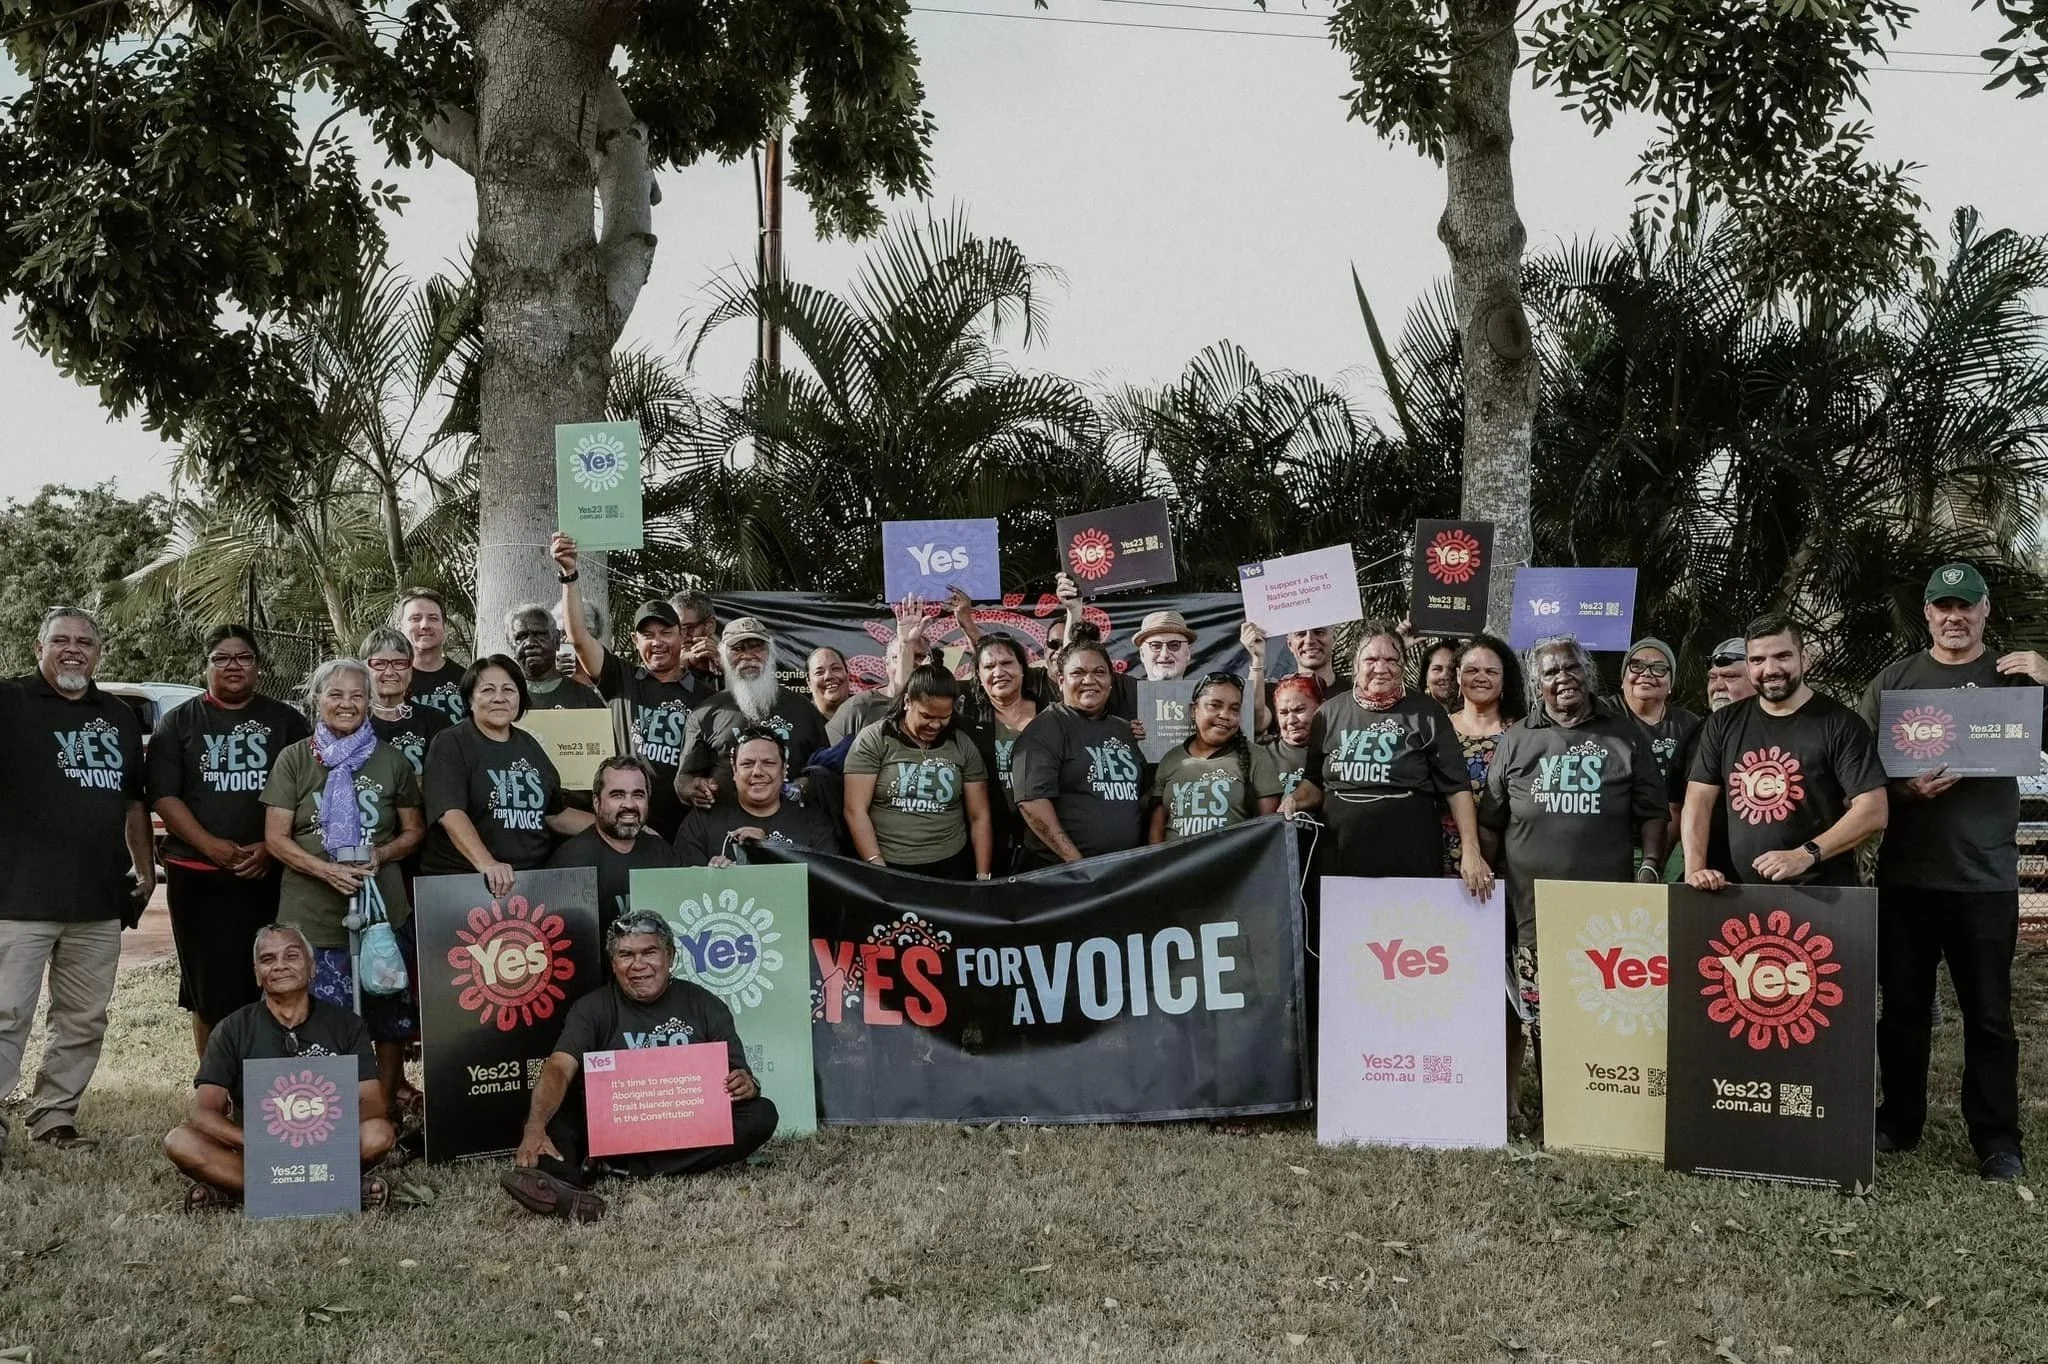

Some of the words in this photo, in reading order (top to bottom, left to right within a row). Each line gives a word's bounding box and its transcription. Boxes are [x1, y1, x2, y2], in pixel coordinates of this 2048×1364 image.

[579, 452, 616, 472] Yes
[578, 504, 602, 514] Yes23
[1121, 538, 1143, 548] Yes23
[907, 543, 969, 576] Yes
[1075, 545, 1105, 563] Yes
[1434, 547, 1469, 565] Yes
[1242, 566, 1261, 577] Yes
[1269, 579, 1301, 590] support
[1310, 573, 1328, 582] First
[1267, 590, 1297, 601] Nations
[1299, 585, 1320, 595] Voice
[1428, 594, 1451, 603] Yes23
[1268, 597, 1311, 611] Parliament
[1529, 599, 1560, 617] Yes
[1579, 601, 1603, 610] Yes23
[1155, 699, 1184, 721] It's
[638, 705, 685, 746] YES
[1901, 722, 1944, 741] Yes
[1969, 724, 2001, 733] Yes23
[54, 731, 123, 770] YES
[203, 733, 268, 771] YES
[643, 743, 680, 766] VOICE
[1339, 729, 1397, 762] YES
[1086, 747, 1138, 782] YES
[1343, 762, 1391, 783] VOICE
[1539, 756, 1601, 792] YES
[64, 768, 82, 779] FOR
[81, 769, 124, 791] VOICE
[203, 771, 219, 782] FOR
[218, 770, 268, 791] VOICE
[487, 769, 544, 809] YES
[898, 762, 954, 803] YES
[1739, 770, 1787, 797] Yes
[1092, 781, 1105, 792] FOR
[1105, 782, 1138, 801] VOICE
[1173, 780, 1230, 816] YES
[892, 797, 907, 807] FOR
[1534, 792, 1549, 803] FOR
[1549, 792, 1600, 814] VOICE
[493, 809, 508, 819] FOR
[507, 810, 544, 830] VOICE
[466, 938, 548, 985] Yes
[679, 930, 757, 974] Yes
[1367, 939, 1448, 980] Yes
[957, 947, 1025, 987] FOR
[1013, 988, 1035, 1025] A
[1025, 921, 1245, 1024] VOICE
[1586, 947, 1668, 990] Yes
[1719, 953, 1811, 1000] Yes
[812, 938, 948, 1026] YES
[467, 1061, 520, 1082] Yes23
[588, 1056, 611, 1069] Yes
[1362, 1054, 1415, 1069] Yes23
[1585, 1062, 1640, 1081] Yes23
[611, 1079, 625, 1089] It's
[627, 1078, 646, 1087] time
[660, 1074, 701, 1085] recognise
[1361, 1071, 1415, 1082] .com.au
[467, 1080, 520, 1096] .com.au
[612, 1089, 656, 1101] Aboriginal
[657, 1088, 674, 1096] and
[676, 1086, 702, 1095] Torres
[1585, 1081, 1640, 1095] .com.au
[1712, 1078, 1772, 1099] Yes23
[272, 1094, 325, 1121] Yes
[612, 1102, 637, 1111] Strait
[639, 1100, 674, 1110] Islander
[675, 1097, 704, 1107] people
[1712, 1099, 1771, 1114] .com.au
[613, 1115, 621, 1123] in
[624, 1114, 638, 1122] the
[640, 1110, 695, 1121] Constitution
[271, 1165, 305, 1177] Yes23
[271, 1176, 306, 1184] .com.au
